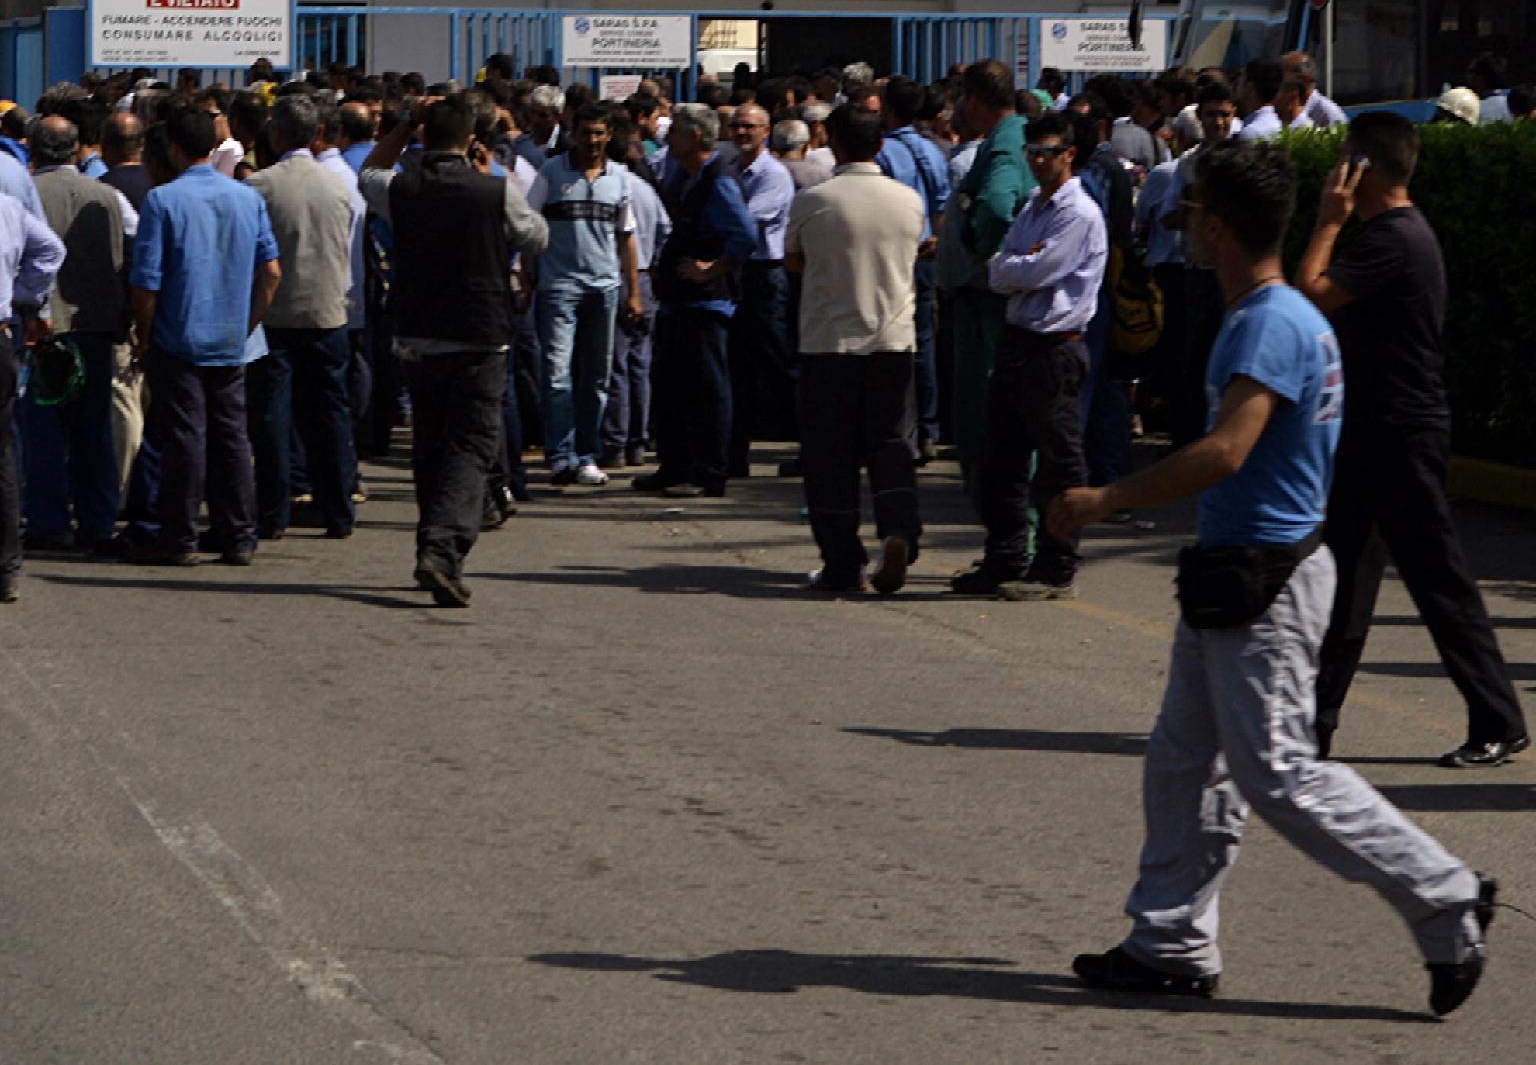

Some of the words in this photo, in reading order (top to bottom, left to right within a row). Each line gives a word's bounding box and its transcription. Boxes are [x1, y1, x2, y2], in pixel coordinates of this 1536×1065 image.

[101, 15, 151, 26] FUMARE
[161, 15, 234, 27] ACCENDERE
[237, 16, 282, 27] FUOCHI
[592, 19, 630, 28] SARAS
[1080, 22, 1117, 31] SARAS
[102, 30, 194, 41] CONSUMARE
[591, 38, 662, 48] PORTINERIA
